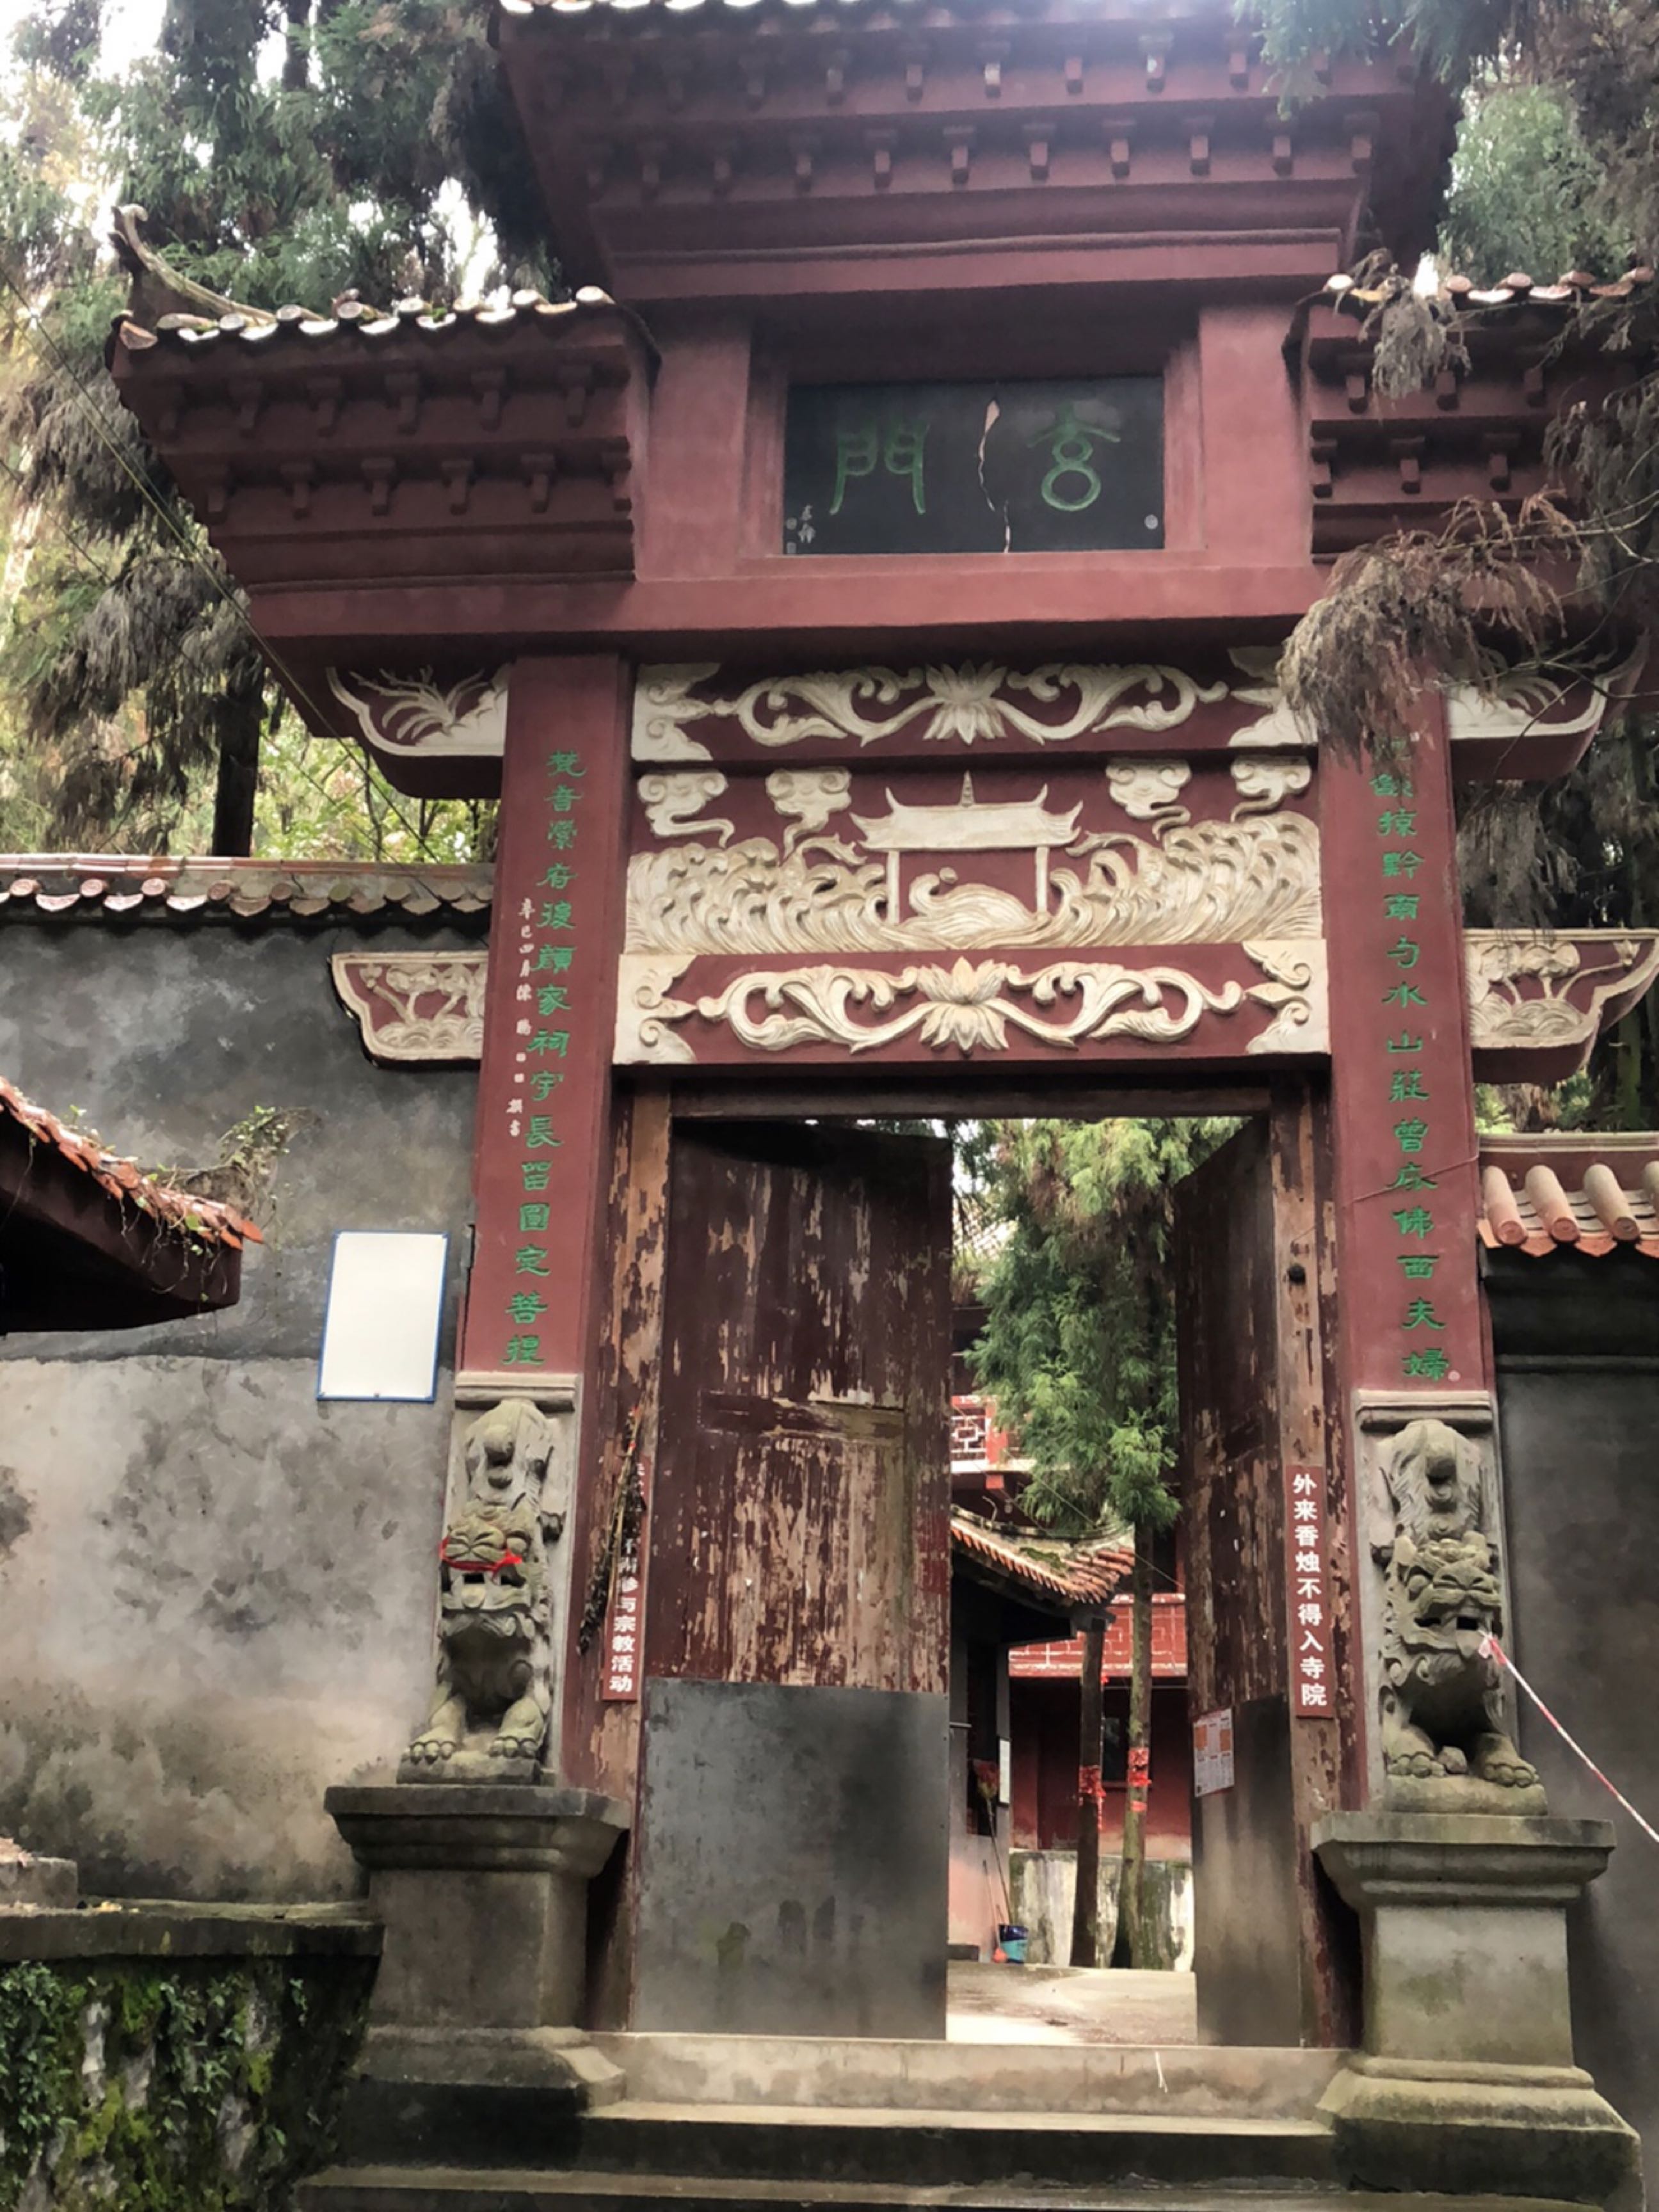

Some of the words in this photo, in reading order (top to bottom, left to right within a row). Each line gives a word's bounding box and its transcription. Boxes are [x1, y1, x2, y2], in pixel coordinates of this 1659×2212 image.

[1293, 1473, 1327, 1707] 外来香烛不得入寺院
